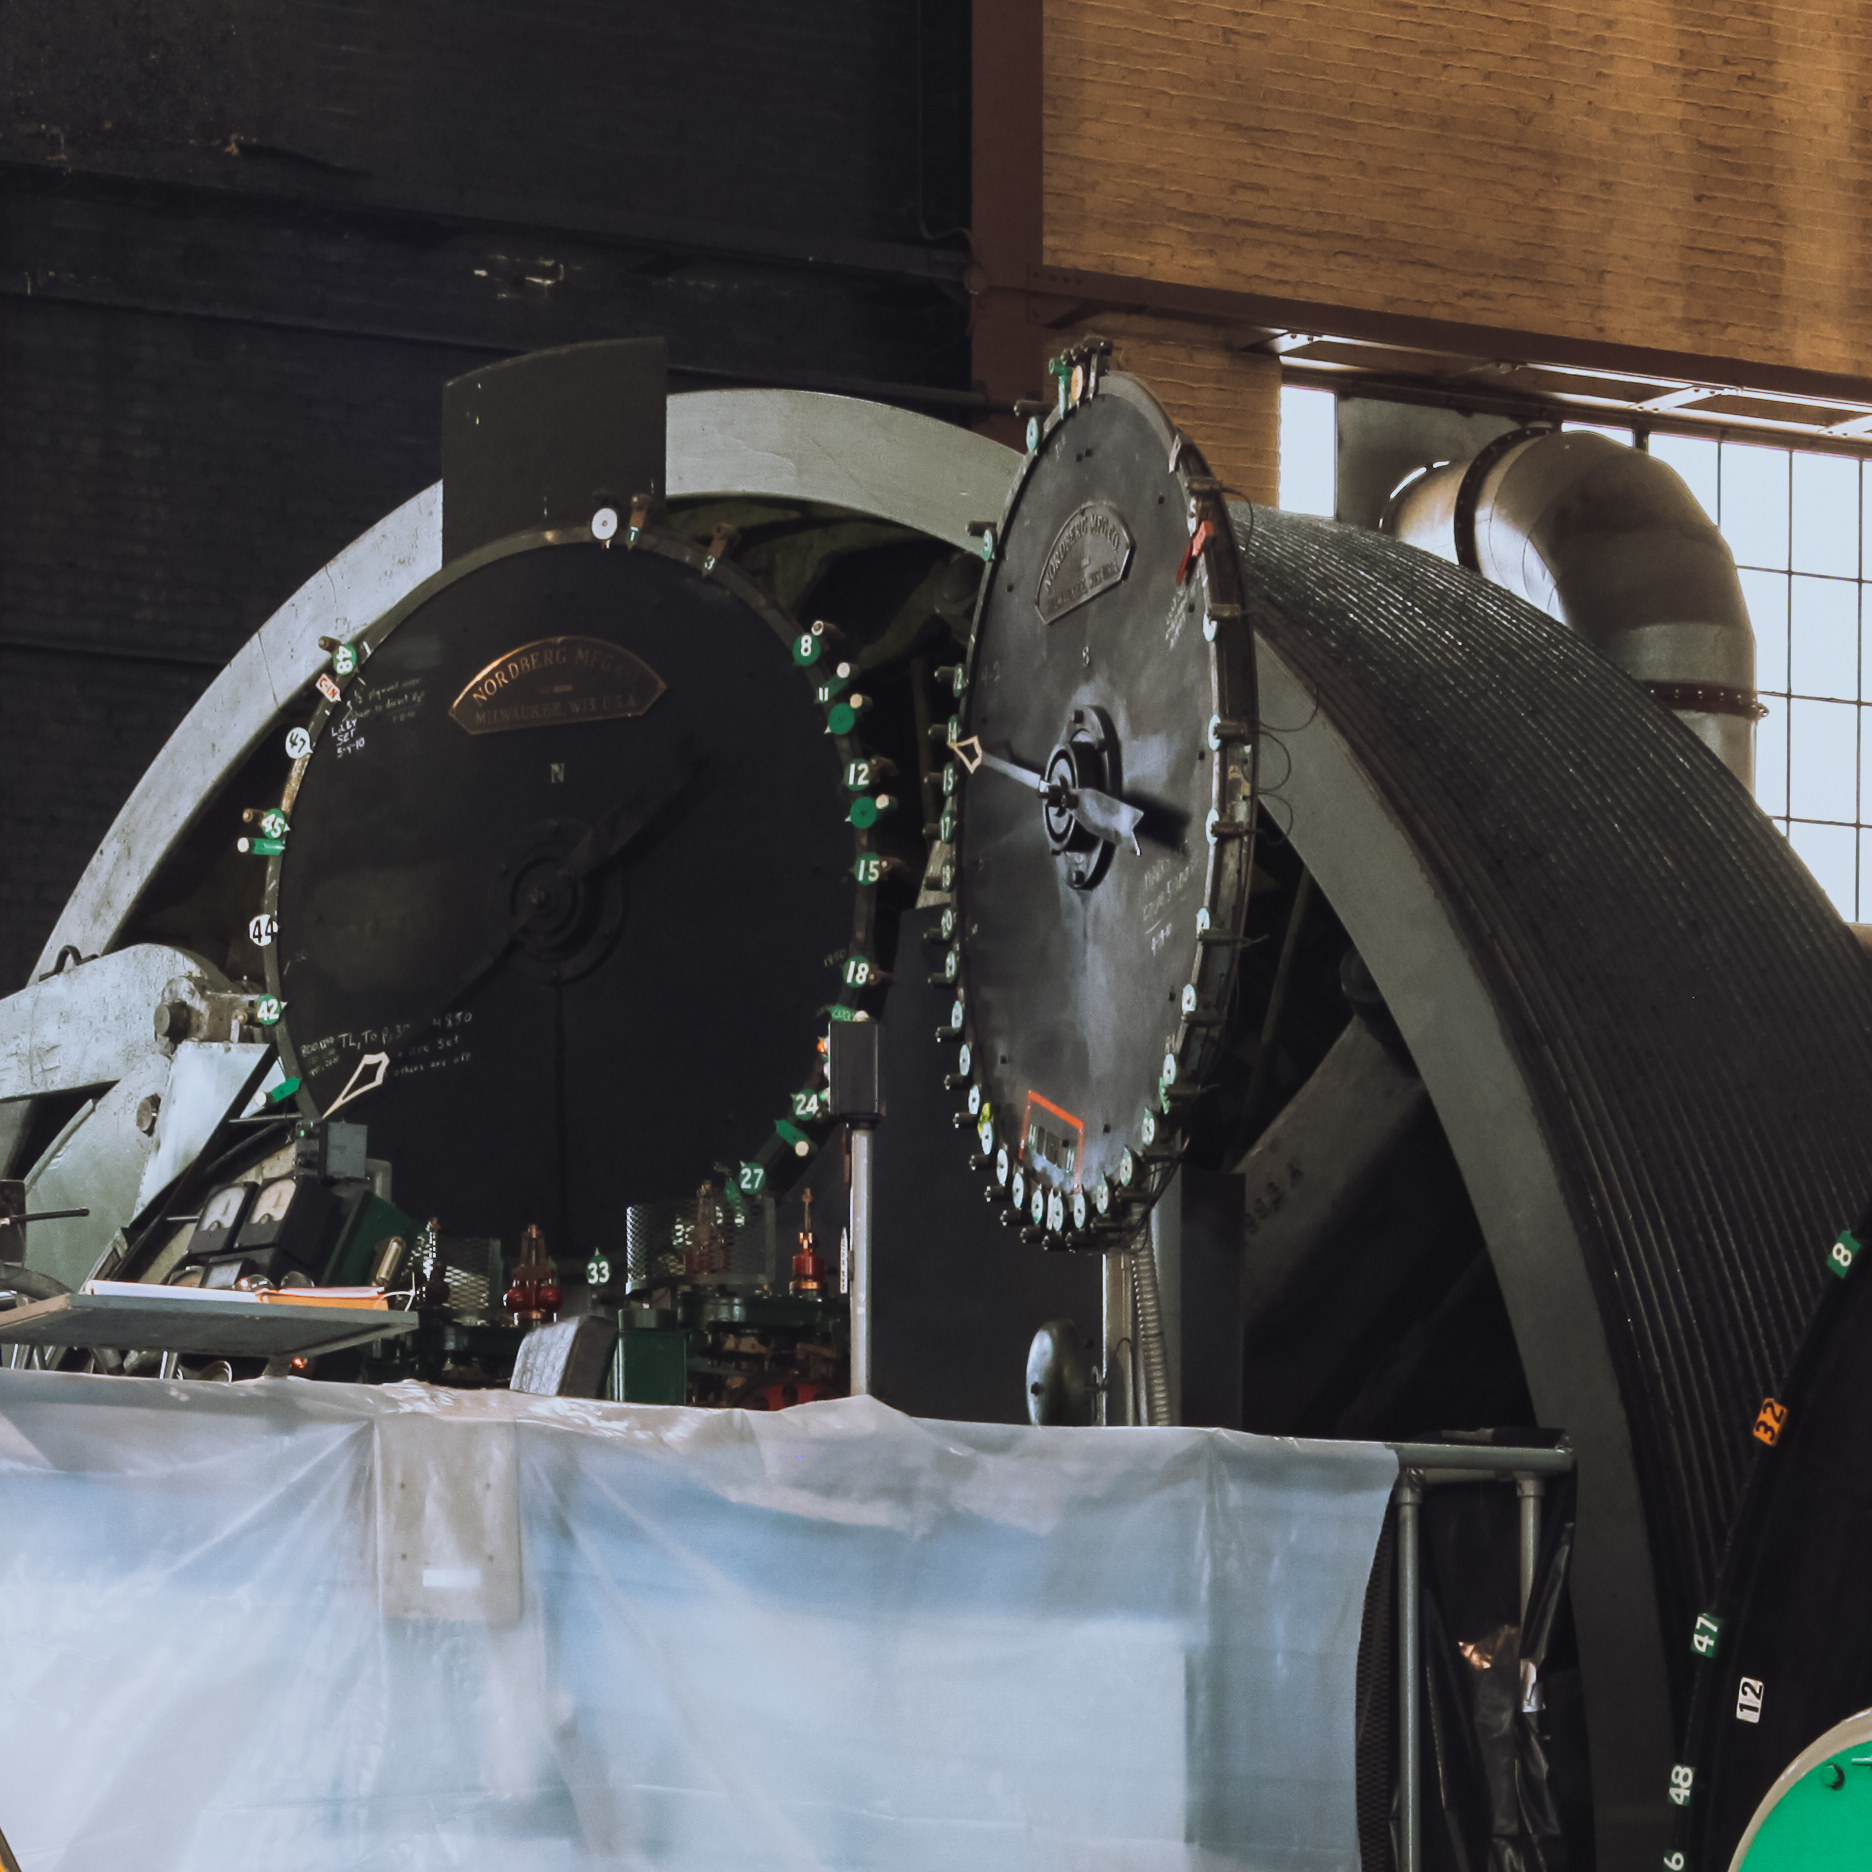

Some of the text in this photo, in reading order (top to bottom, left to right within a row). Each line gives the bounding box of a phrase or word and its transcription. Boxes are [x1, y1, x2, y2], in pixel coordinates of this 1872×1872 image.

[704, 555, 715, 570] 3
[800, 634, 812, 657] 8
[335, 646, 354, 675] 48
[472, 648, 567, 707] NORDBERG
[288, 731, 307, 755] 47
[550, 762, 565, 784] N
[848, 763, 870, 786] 12
[262, 814, 285, 838] 45
[857, 859, 881, 882] 15
[251, 918, 275, 944] 44
[846, 960, 869, 984] 18
[257, 998, 280, 1020] 42
[794, 1094, 819, 1116] 24
[740, 1168, 764, 1189] 27
[1832, 1242, 1853, 1267] 8
[587, 1261, 610, 1285] 33
[1755, 1401, 1785, 1443] 32
[1693, 1614, 1720, 1655] 47
[1739, 1680, 1764, 1715] 12
[1668, 1764, 1694, 1806] 48
